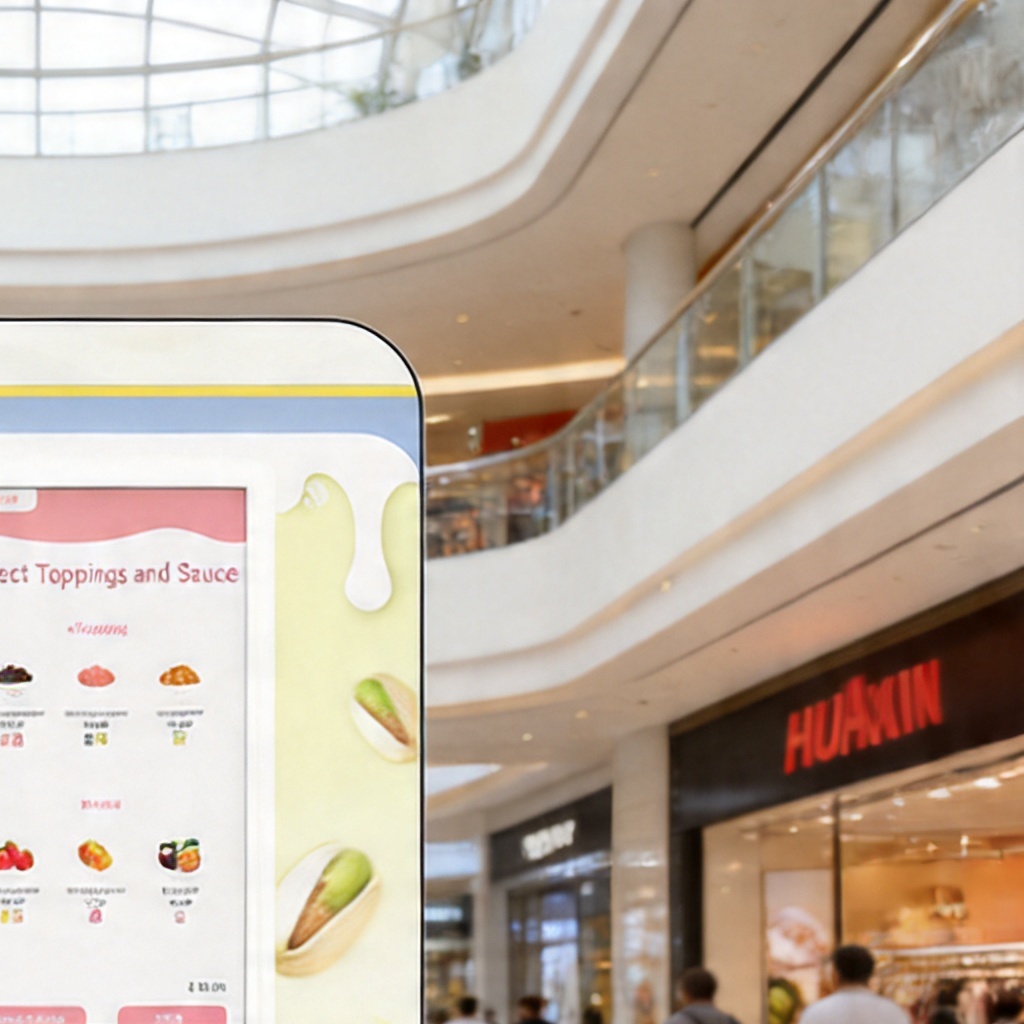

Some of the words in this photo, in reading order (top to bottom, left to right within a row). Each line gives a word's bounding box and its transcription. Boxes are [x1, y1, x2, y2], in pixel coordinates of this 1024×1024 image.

[36, 562, 127, 590] Toppings
[133, 562, 170, 583] and
[177, 562, 240, 584] Sauce
